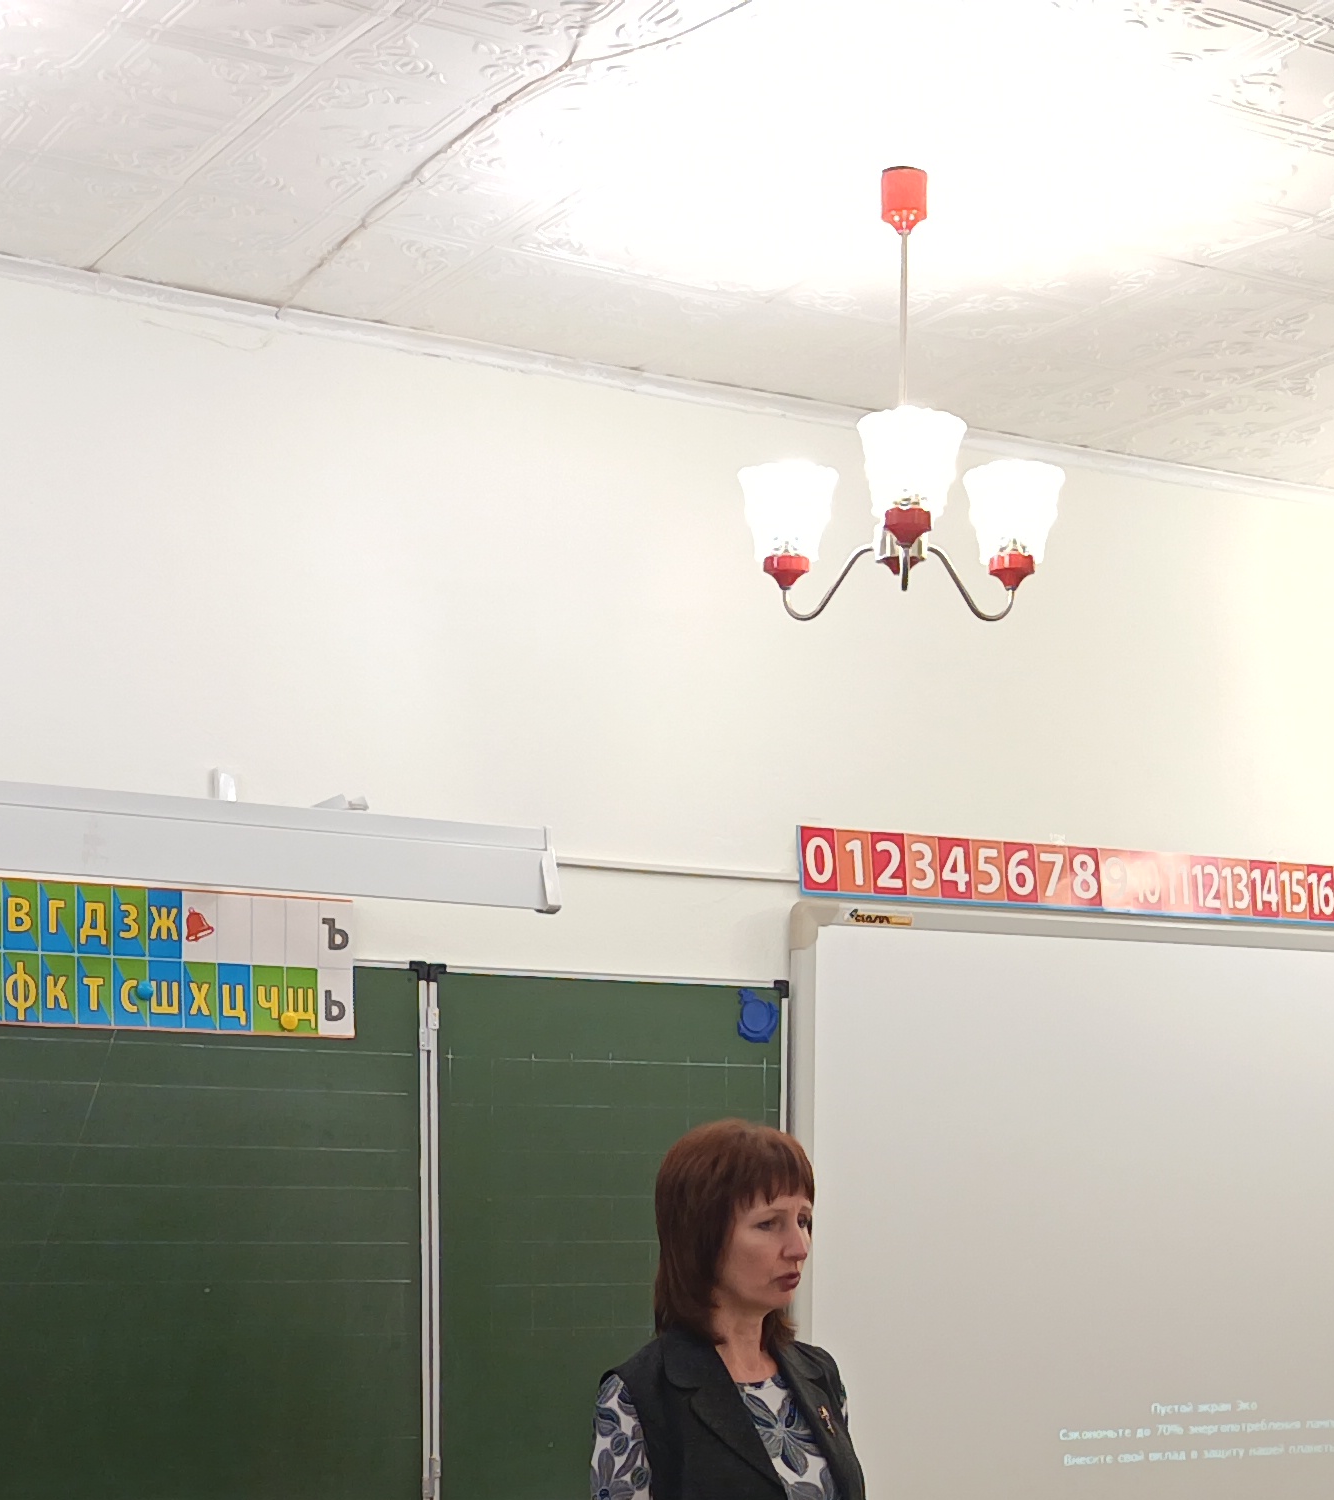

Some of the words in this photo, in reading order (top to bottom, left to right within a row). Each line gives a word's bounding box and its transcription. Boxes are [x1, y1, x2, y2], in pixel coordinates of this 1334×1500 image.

[805, 836, 834, 884] 0
[845, 839, 864, 886] 1
[875, 840, 903, 888] 2
[911, 842, 936, 889] 3
[942, 846, 969, 893] 4
[977, 848, 1001, 894] 5
[1007, 850, 1035, 895] 6
[1039, 853, 1064, 896] 7
[1072, 854, 1099, 899] 8
[1104, 856, 1128, 899] 9
[1192, 864, 1222, 908] 12
[1220, 865, 1250, 909] 13
[1250, 868, 1279, 912] 14
[1279, 870, 1307, 913] 15
[1307, 872, 1334, 916] 16
[1151, 1402, 1193, 1416] Пустой
[1198, 1403, 1231, 1413] экран
[1237, 1400, 1258, 1411] Эко
[1136, 1428, 1151, 1438] до
[1156, 1424, 1184, 1436] 70%
[1117, 1450, 1144, 1463] свой
[1148, 1450, 1186, 1462] вклад
[1203, 1448, 1245, 1459] защиту
